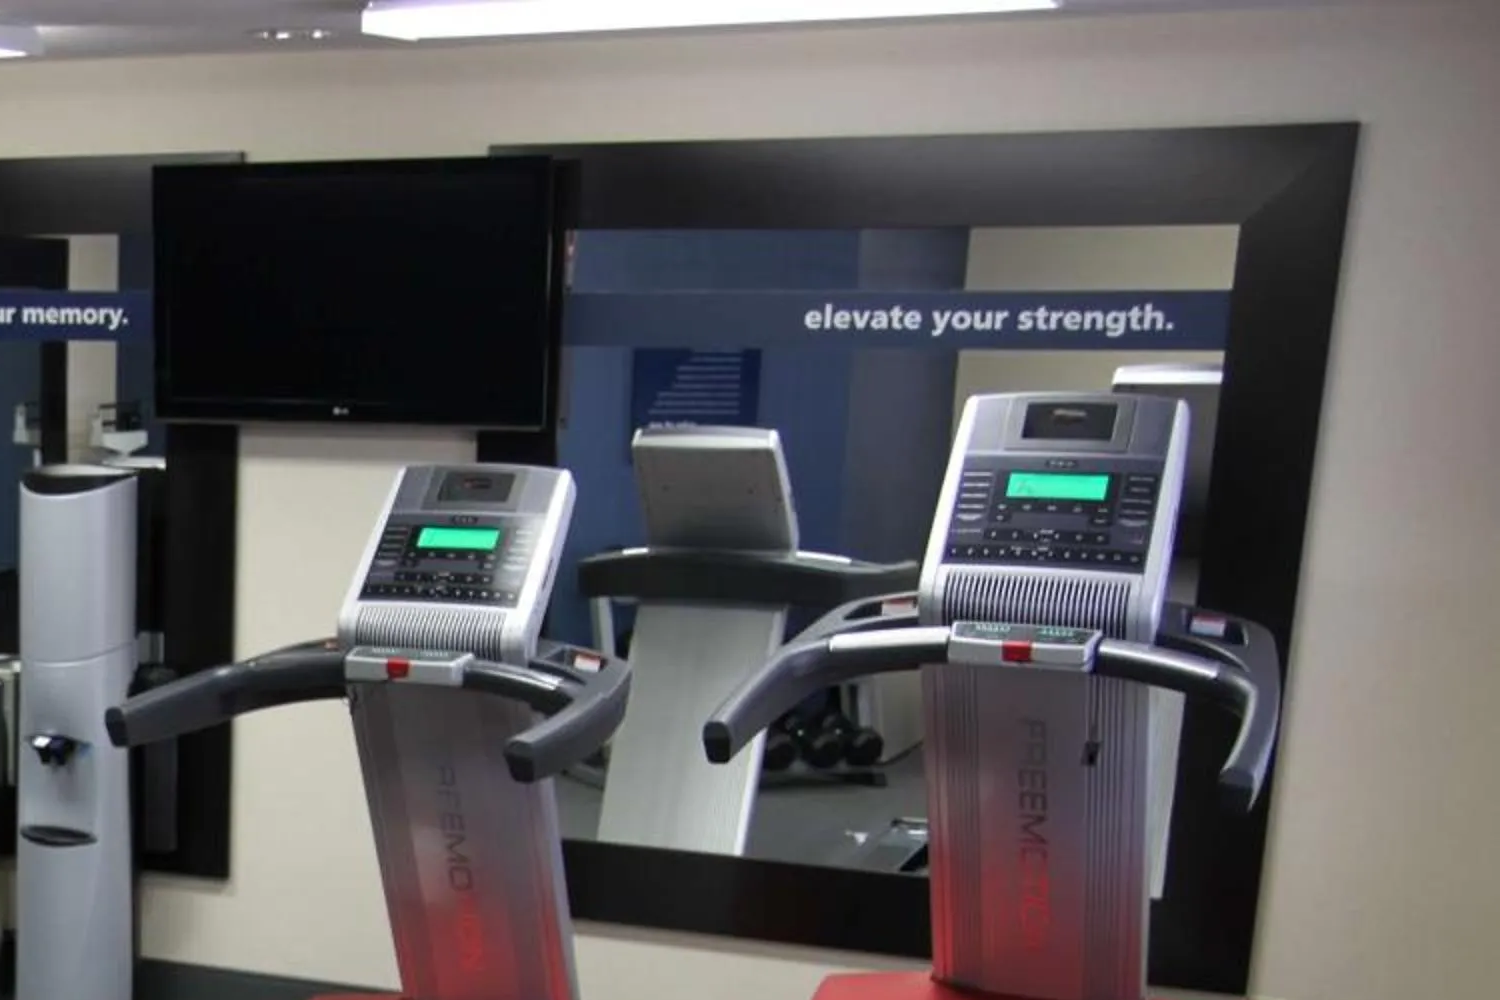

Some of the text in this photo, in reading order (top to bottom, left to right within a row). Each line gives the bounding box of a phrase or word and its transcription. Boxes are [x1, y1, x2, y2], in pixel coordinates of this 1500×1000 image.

[21, 306, 129, 331] memory.
[804, 303, 1174, 338] elevate your strength.
